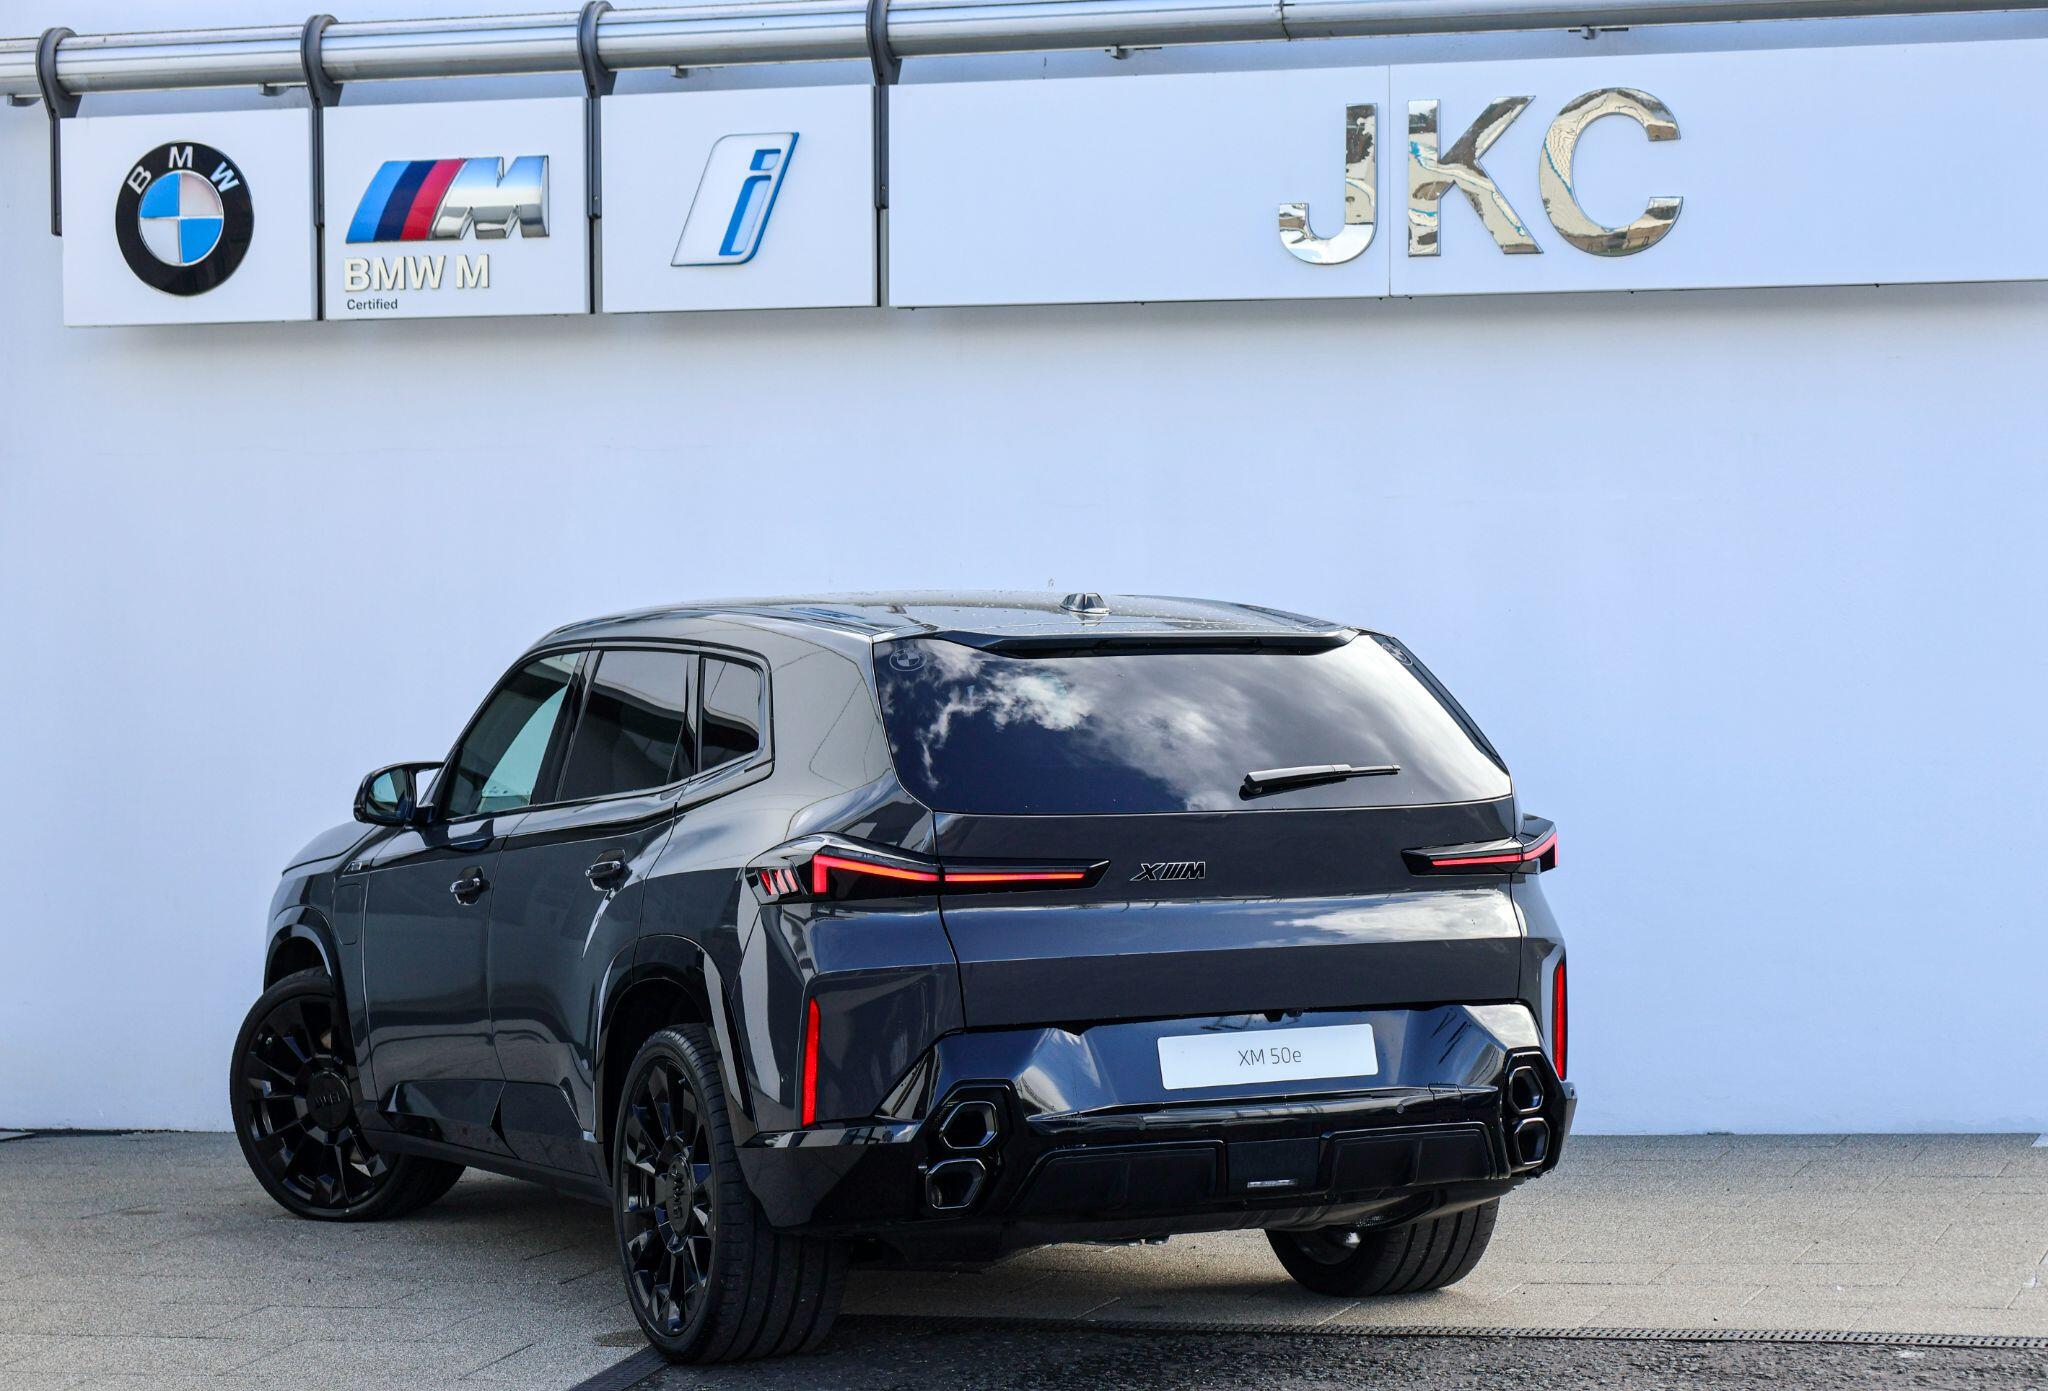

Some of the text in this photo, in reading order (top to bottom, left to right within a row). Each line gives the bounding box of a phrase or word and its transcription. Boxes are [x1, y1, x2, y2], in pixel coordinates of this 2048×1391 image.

[127, 145, 240, 195] BMW
[1279, 86, 1684, 265] JKC
[427, 154, 550, 241] M
[344, 254, 490, 292] BMW M
[346, 298, 398, 310] Certified
[1237, 1046, 1302, 1066] XM 50e
